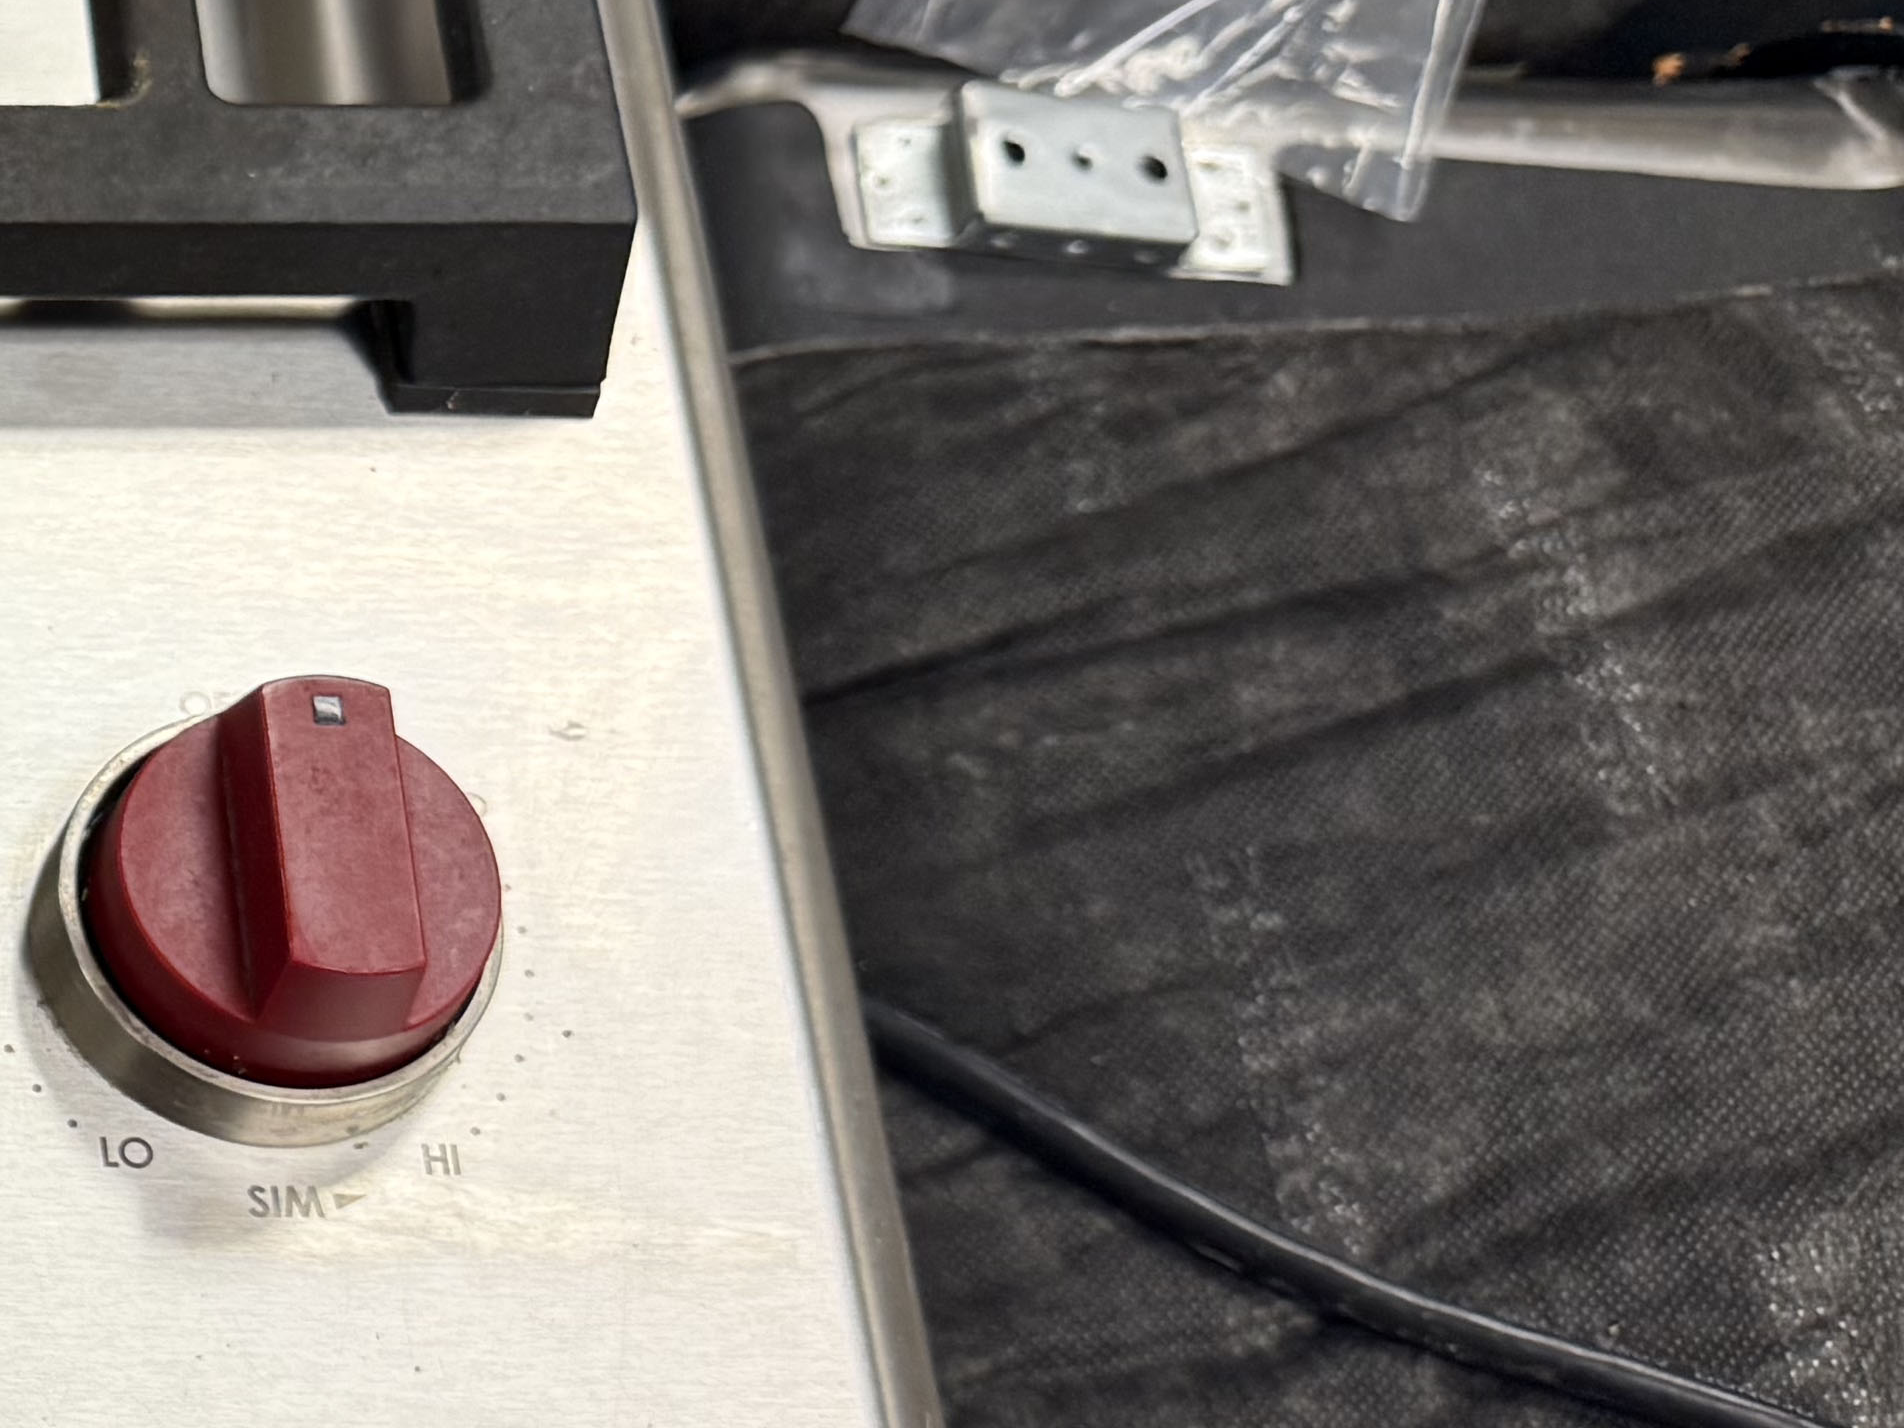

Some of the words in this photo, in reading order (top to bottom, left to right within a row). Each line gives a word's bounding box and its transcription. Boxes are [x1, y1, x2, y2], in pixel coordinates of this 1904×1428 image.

[100, 1136, 153, 1170] LO
[422, 1144, 461, 1176] HI
[247, 1184, 325, 1218] SIM
